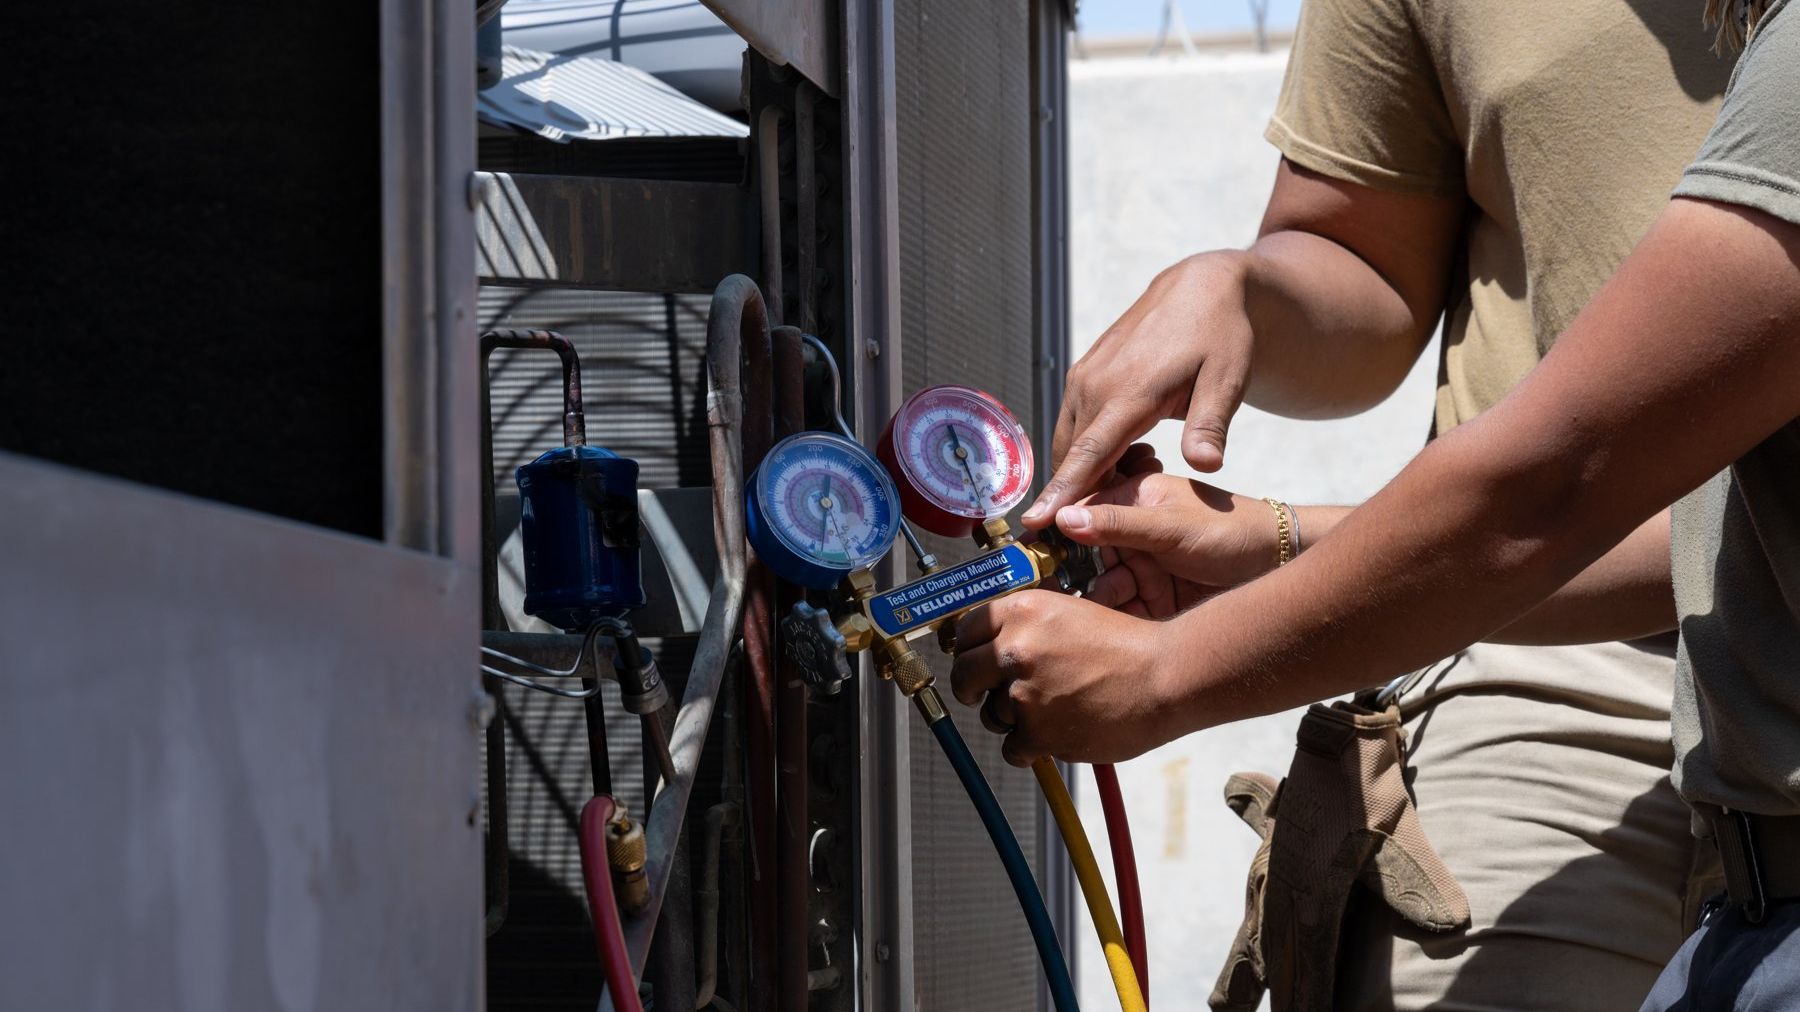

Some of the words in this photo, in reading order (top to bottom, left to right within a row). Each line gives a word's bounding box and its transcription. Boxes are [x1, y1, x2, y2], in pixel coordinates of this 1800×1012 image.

[807, 444, 823, 452] 200
[886, 594, 907, 607] Test
[909, 586, 926, 600] and
[927, 570, 967, 592] Charging
[969, 553, 1008, 577] Manifold
[912, 592, 966, 616] YELLOW
[967, 570, 1013, 595] JACKET
